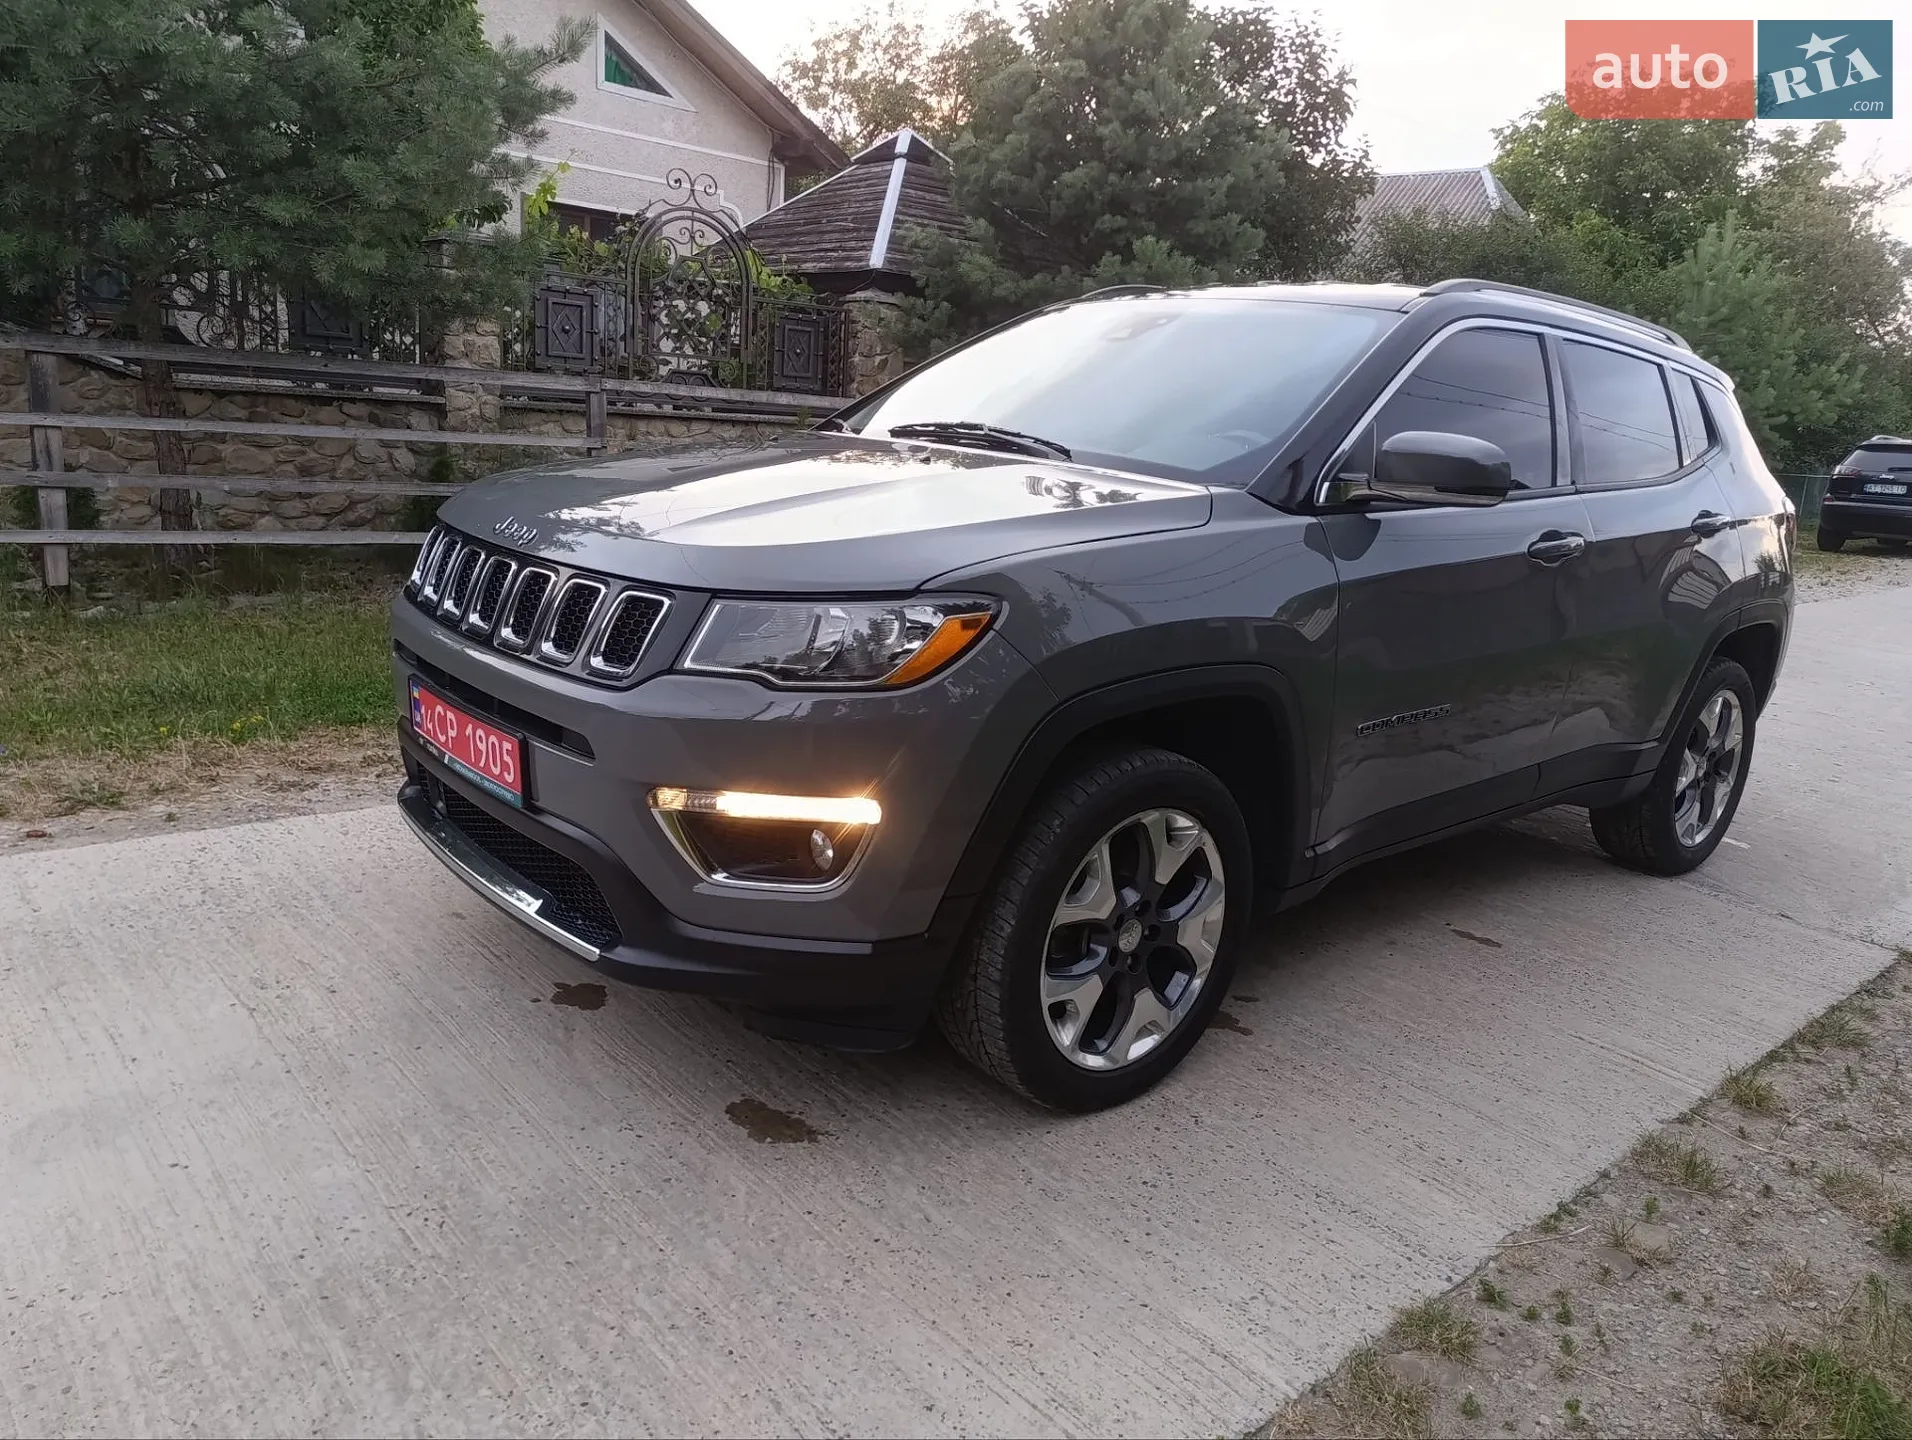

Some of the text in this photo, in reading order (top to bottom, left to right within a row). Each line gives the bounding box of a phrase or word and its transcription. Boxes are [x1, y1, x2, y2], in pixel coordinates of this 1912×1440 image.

[493, 516, 537, 546] Jeep
[1356, 703, 1451, 737] COMPASS
[465, 723, 515, 783] 1905
